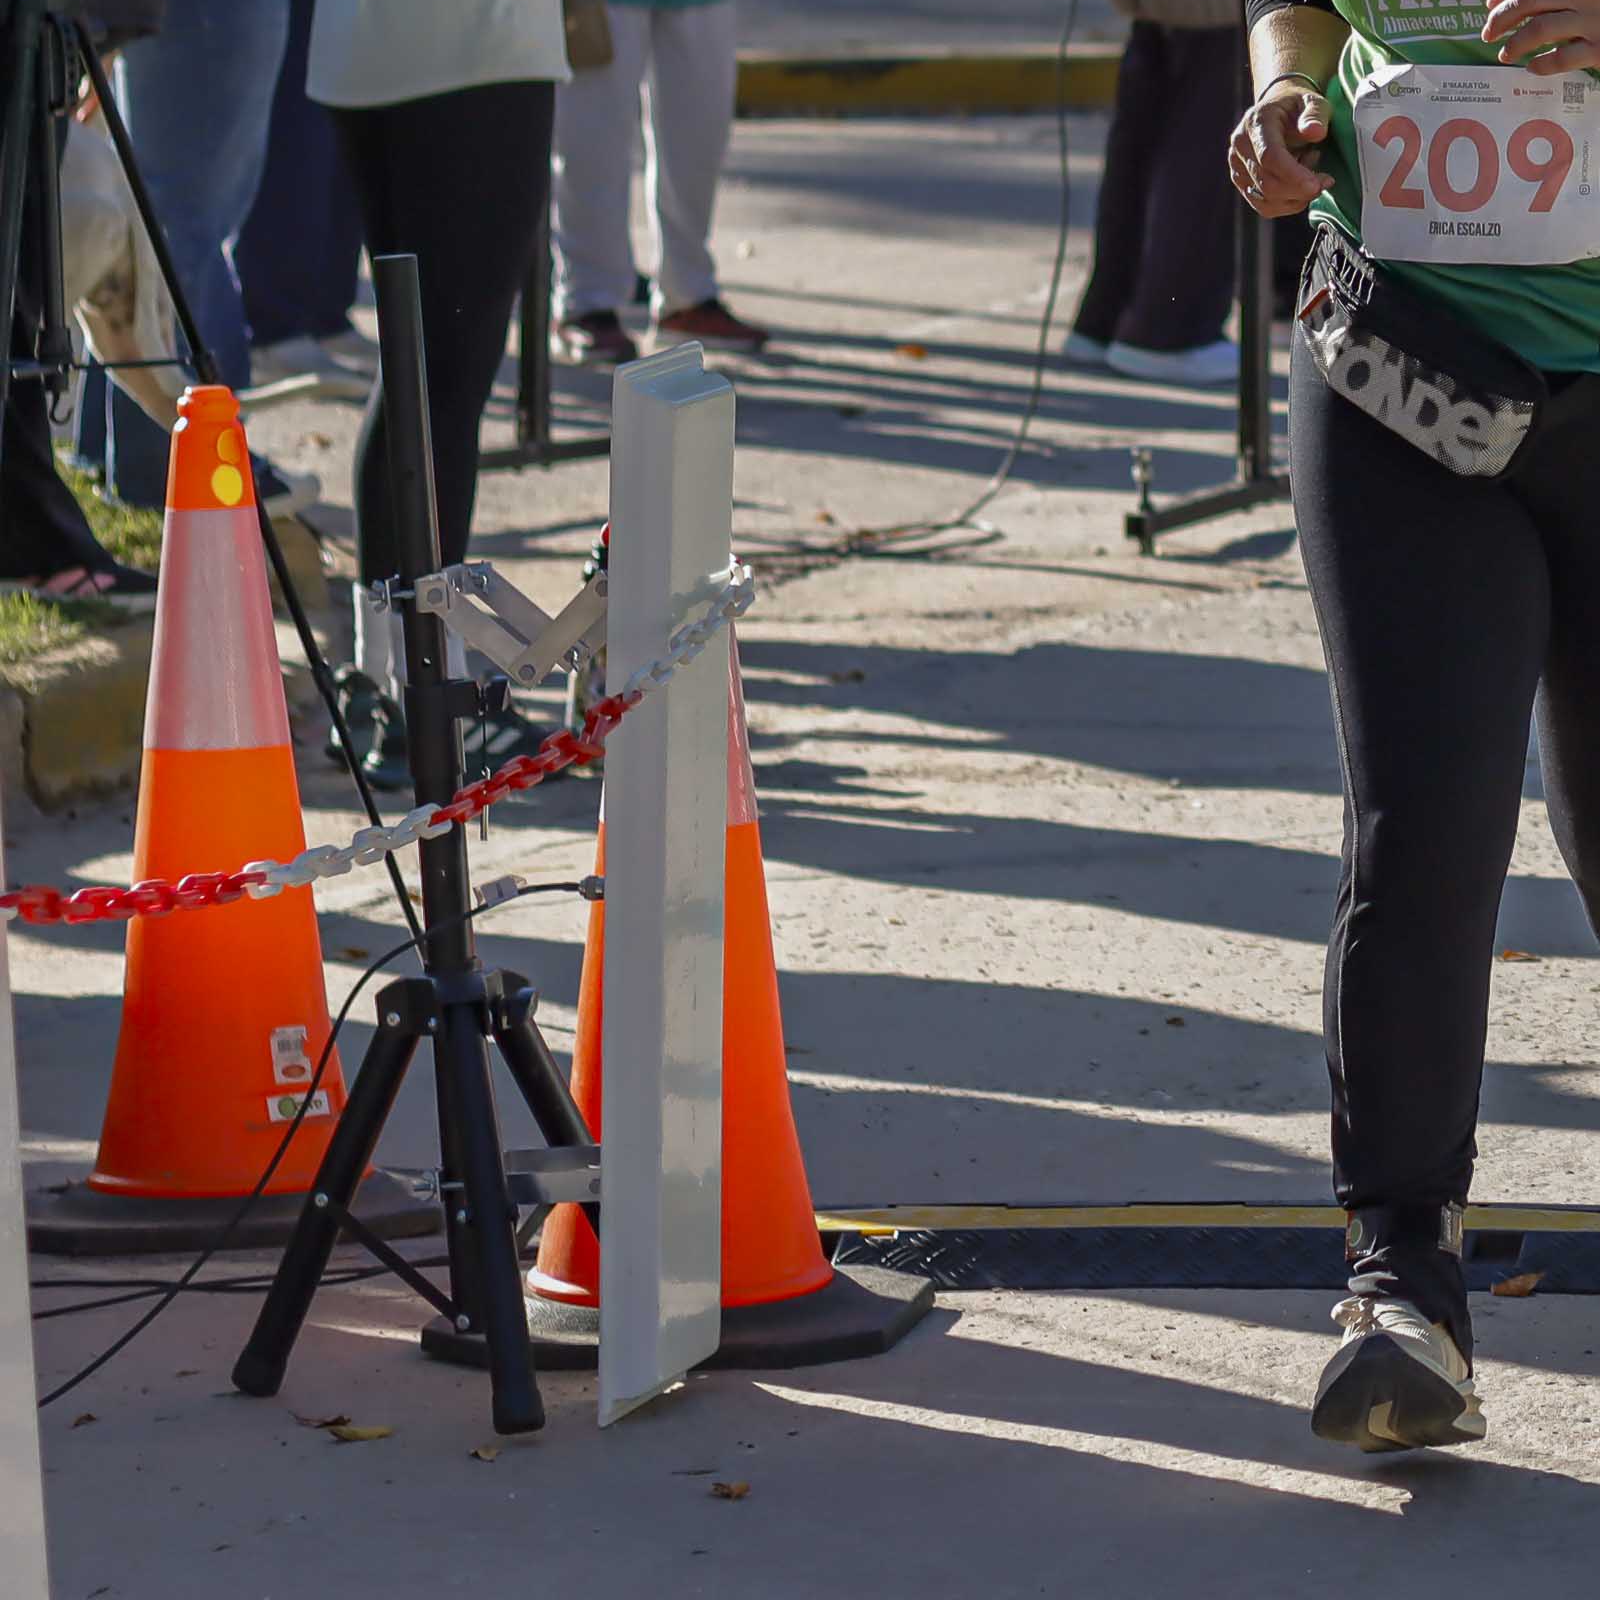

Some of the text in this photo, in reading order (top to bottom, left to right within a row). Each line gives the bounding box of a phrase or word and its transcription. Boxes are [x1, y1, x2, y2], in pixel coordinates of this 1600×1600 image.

[1383, 12, 1458, 34] Almacenes
[1371, 115, 1575, 214] 209
[1428, 221, 1502, 238] ERICA ESCALZO
